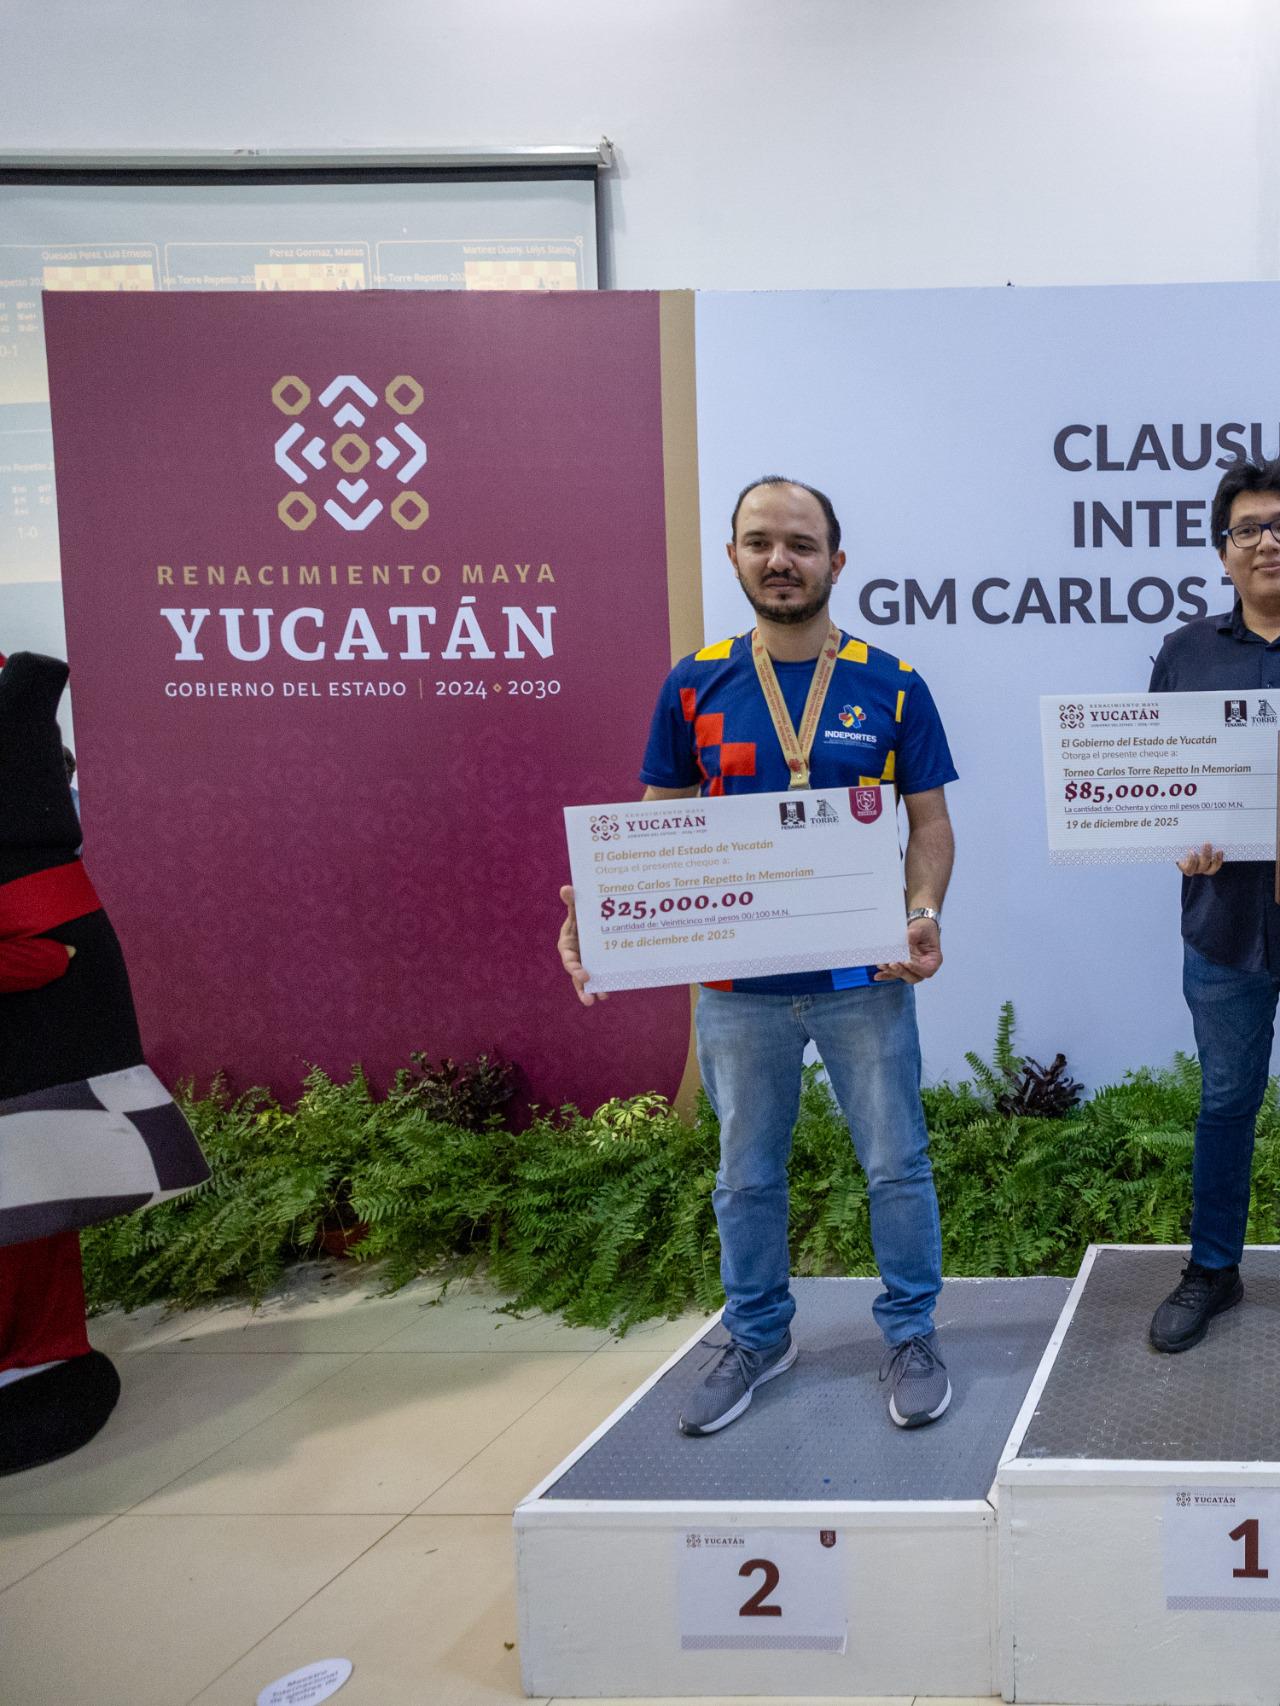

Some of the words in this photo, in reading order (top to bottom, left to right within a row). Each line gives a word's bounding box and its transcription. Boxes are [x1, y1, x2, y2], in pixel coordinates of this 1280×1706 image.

[157, 564, 442, 586] RENACIMIENTO
[461, 563, 556, 584] MAYA
[858, 577, 956, 626] GM
[971, 576, 1208, 625] CARLOS
[159, 595, 557, 661] YUCATÁN
[165, 682, 274, 698] GOBIERNO
[283, 682, 321, 697] DEL
[329, 681, 407, 697] ESTADO
[436, 680, 487, 699] 2024
[508, 679, 561, 699] 2030
[1090, 708, 1159, 721] YUCATÁN
[824, 730, 877, 742] INDEPORTES
[1061, 739, 1069, 748] El
[1072, 738, 1114, 747] Gobierno
[1117, 737, 1131, 746] del
[1133, 736, 1164, 746] Estado
[1166, 736, 1178, 745] de
[1180, 734, 1217, 744] Yucatán
[1062, 752, 1090, 761] Otorga
[1093, 750, 1100, 759] el
[1102, 751, 1137, 760] presente
[1139, 749, 1168, 758] cheque
[1064, 768, 1094, 777] Torneo
[1097, 767, 1125, 776] Carlos
[1128, 766, 1150, 775] Torre
[1153, 766, 1188, 777] Repetto
[1190, 765, 1199, 774] In
[1202, 765, 1251, 774] Memoriam
[1065, 781, 1197, 803] $85,000.00
[1181, 804, 1200, 812] pesos
[1201, 801, 1227, 810] 00/100
[626, 815, 706, 832] YUCATÁN
[810, 815, 839, 825] TORRE
[1066, 820, 1078, 829] 19
[1081, 820, 1092, 828] de
[1094, 818, 1138, 828] diciembre
[1141, 818, 1151, 826] de
[1154, 817, 1179, 827] 2025
[594, 852, 604, 862] El
[607, 849, 656, 861] Gobierno
[659, 848, 675, 859] del
[678, 845, 713, 857] Estado
[716, 842, 729, 852] de
[731, 839, 774, 851] Yucatán
[598, 882, 634, 893] Torneo
[637, 879, 671, 890] Carlos
[673, 877, 700, 888] Torre
[703, 873, 743, 886] Repetto
[745, 871, 756, 881] In
[758, 868, 814, 881] Memoriam
[601, 891, 754, 920] $25,000.00
[612, 922, 645, 932] cantidad
[660, 917, 703, 927] Veinticinco
[704, 915, 716, 923] mil
[718, 914, 740, 924] pesos
[741, 910, 769, 920] 00/100
[604, 940, 618, 950] 19
[621, 937, 634, 949] de
[636, 933, 689, 947] diciembre
[691, 931, 705, 942] de
[708, 929, 736, 941] 2025
[1228, 1519, 1269, 1578] 1
[738, 1558, 782, 1617] 2
